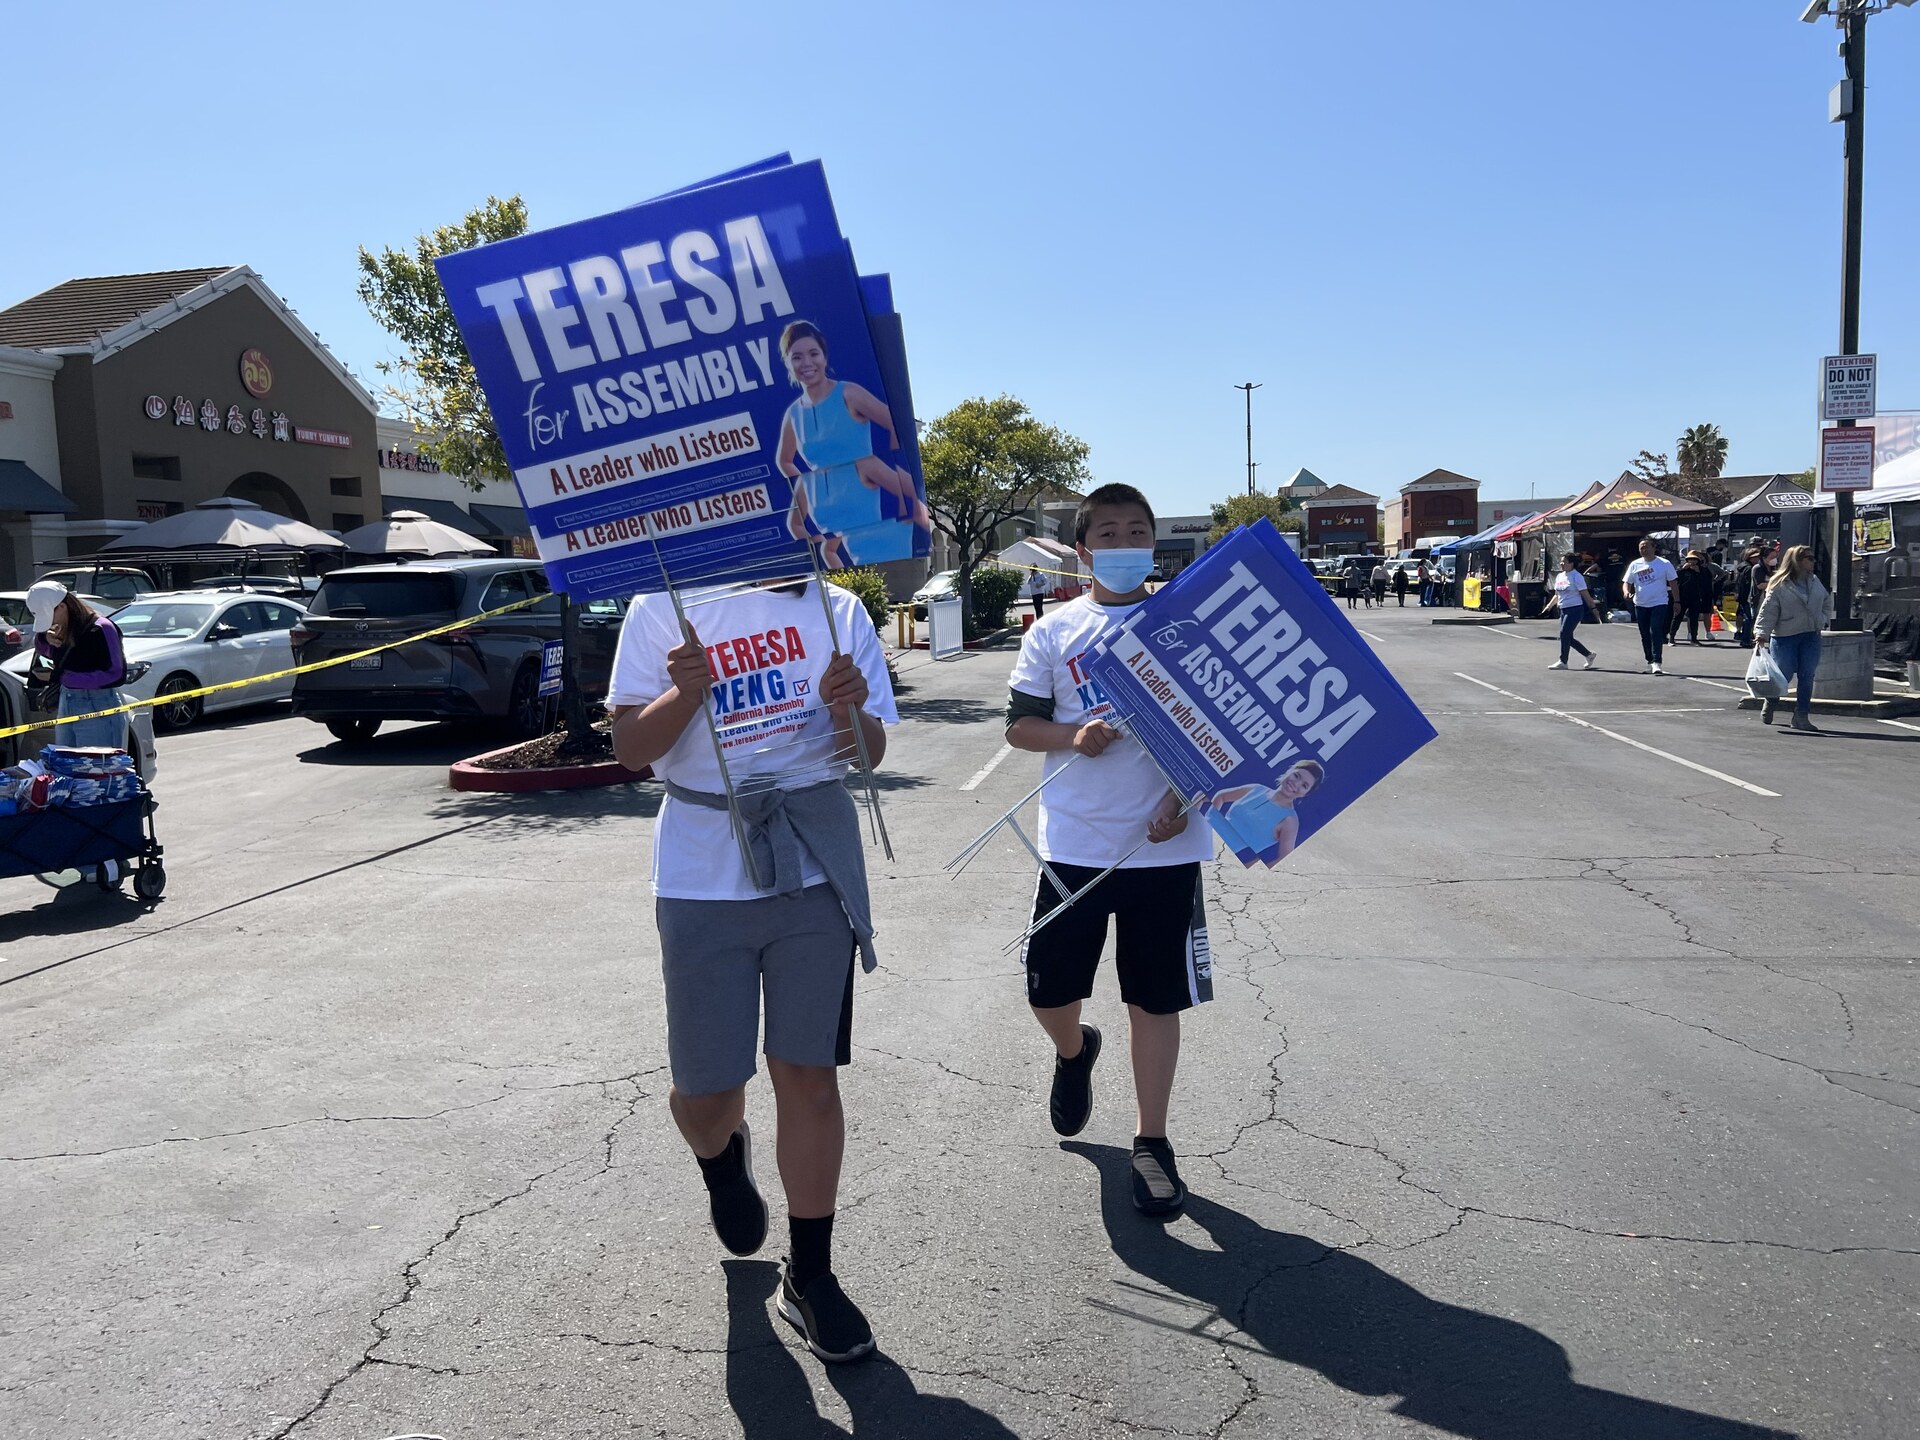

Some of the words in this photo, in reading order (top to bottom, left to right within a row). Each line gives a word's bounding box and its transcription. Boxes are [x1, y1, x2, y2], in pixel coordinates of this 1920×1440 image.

[476, 215, 795, 382] TERESA
[1828, 357, 1873, 366] ATTENTION
[1829, 369, 1845, 383] DO
[1848, 368, 1872, 382] NOT
[523, 383, 569, 451] for
[572, 337, 774, 432] ASSEMBLY
[297, 430, 317, 441] YUMMY
[318, 433, 338, 443] YUMMY
[339, 435, 350, 445] BAO
[550, 467, 568, 495] A
[566, 455, 634, 488] Leader
[637, 442, 679, 472] who
[680, 425, 755, 462] Listens
[566, 529, 581, 551] A
[583, 517, 647, 547] Leader
[651, 504, 692, 532] who
[694, 488, 767, 523] Listens
[1757, 516, 1775, 525] get
[705, 626, 806, 682] TERESA
[1193, 560, 1377, 762] TERESA
[723, 707, 763, 725] California
[764, 698, 805, 715] Assembly
[1127, 650, 1145, 667] A
[1137, 659, 1177, 705] Leader
[1170, 700, 1197, 730] who
[1190, 720, 1234, 772] Listens
[1150, 619, 1198, 651] for
[1178, 644, 1301, 768] ASSEMBLY
